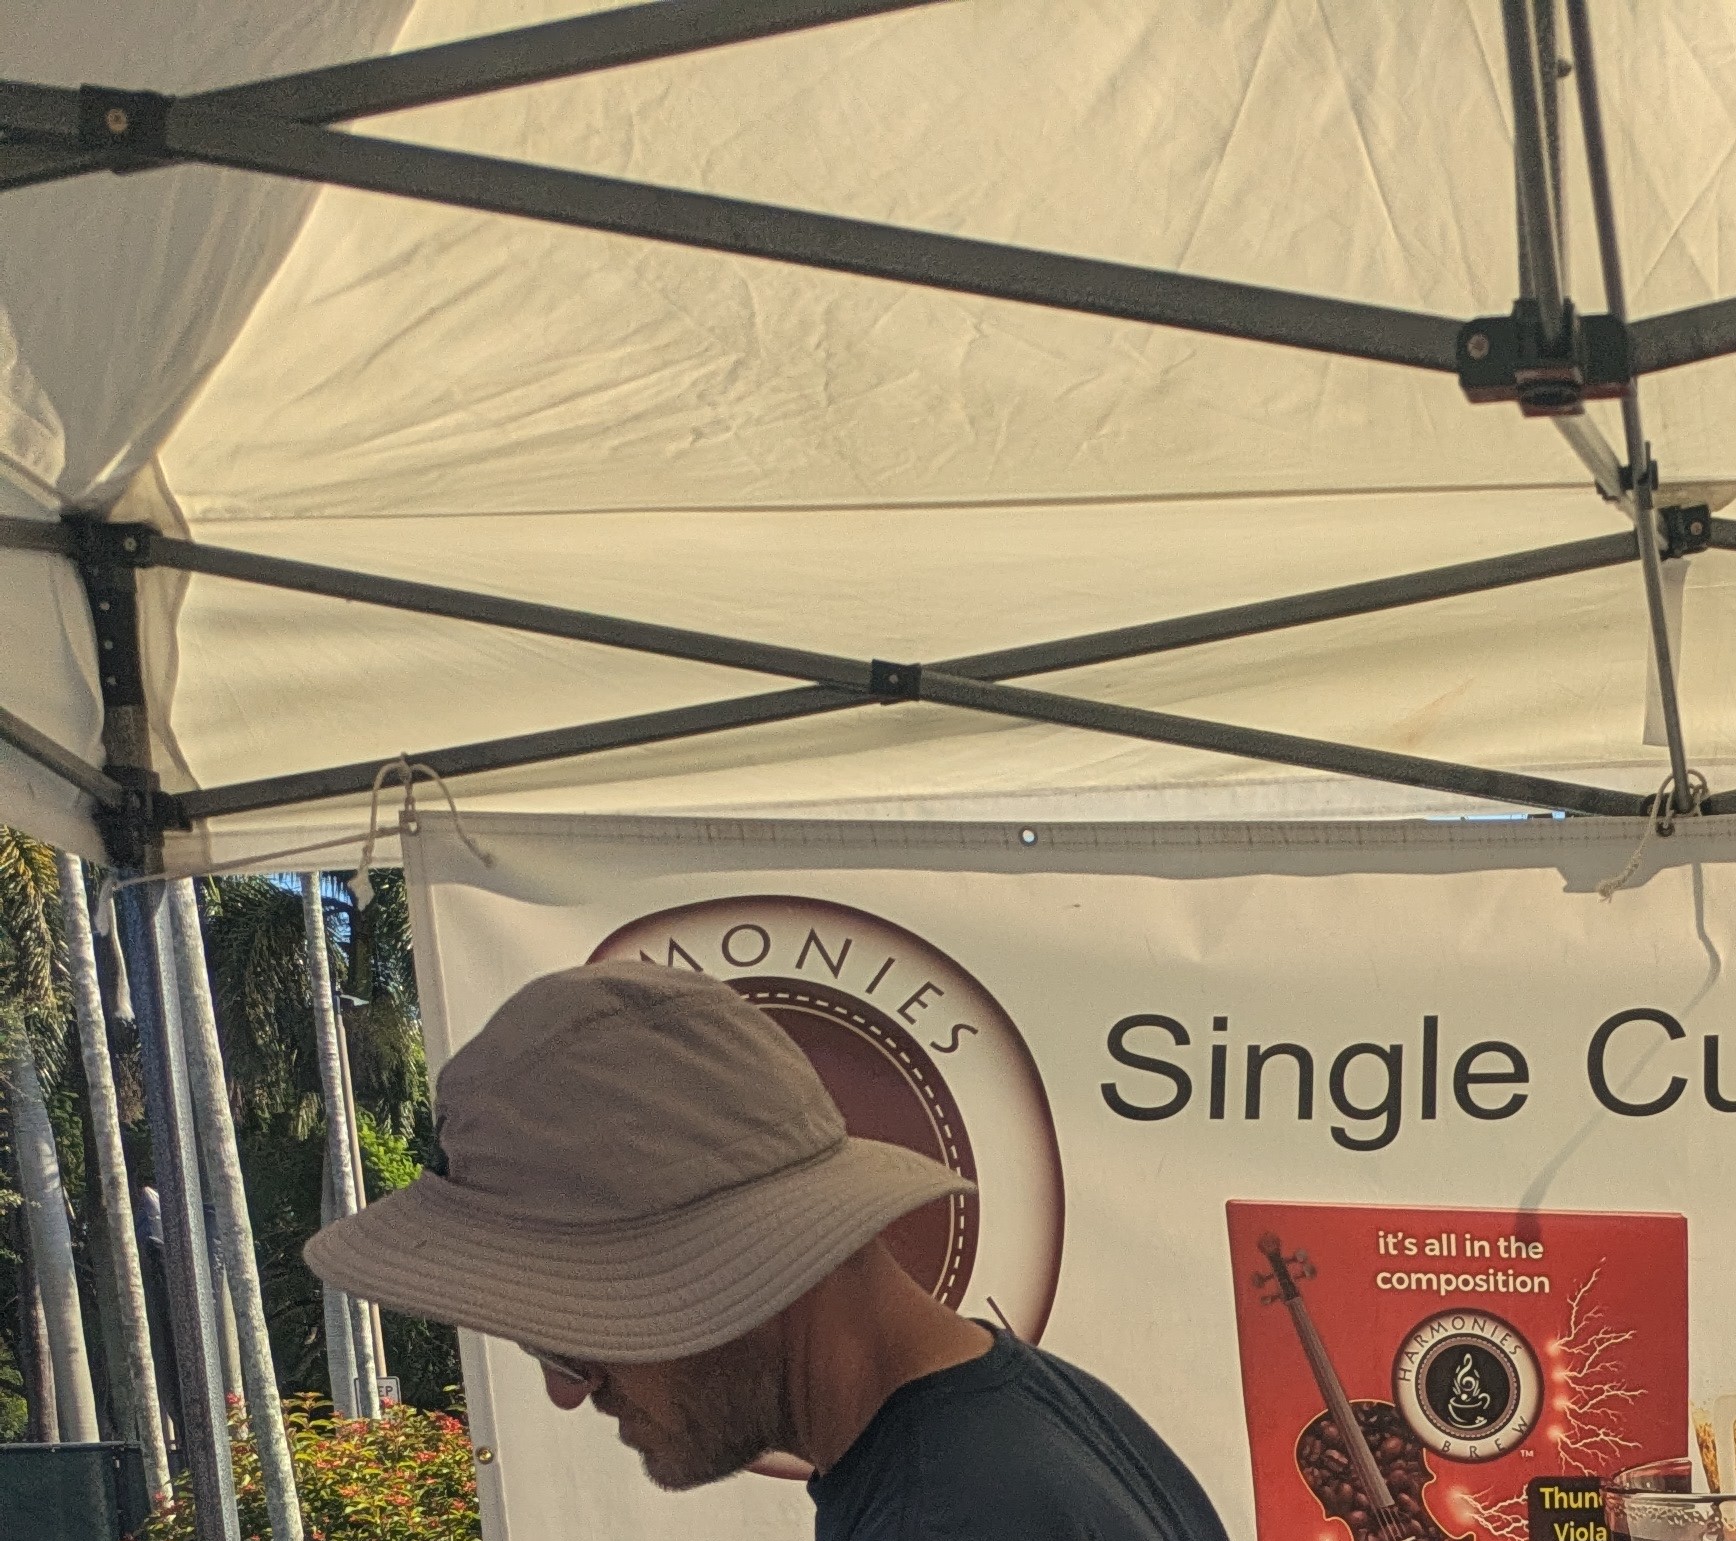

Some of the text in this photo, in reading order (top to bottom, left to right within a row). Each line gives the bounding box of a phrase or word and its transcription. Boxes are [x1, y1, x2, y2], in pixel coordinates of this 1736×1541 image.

[1099, 1012, 1530, 1152] Single
[1378, 1231, 1544, 1258] it's all in the
[1376, 1268, 1550, 1295] composition
[1399, 1315, 1522, 1381] HARMONIES
[1441, 1415, 1531, 1459] BREW
